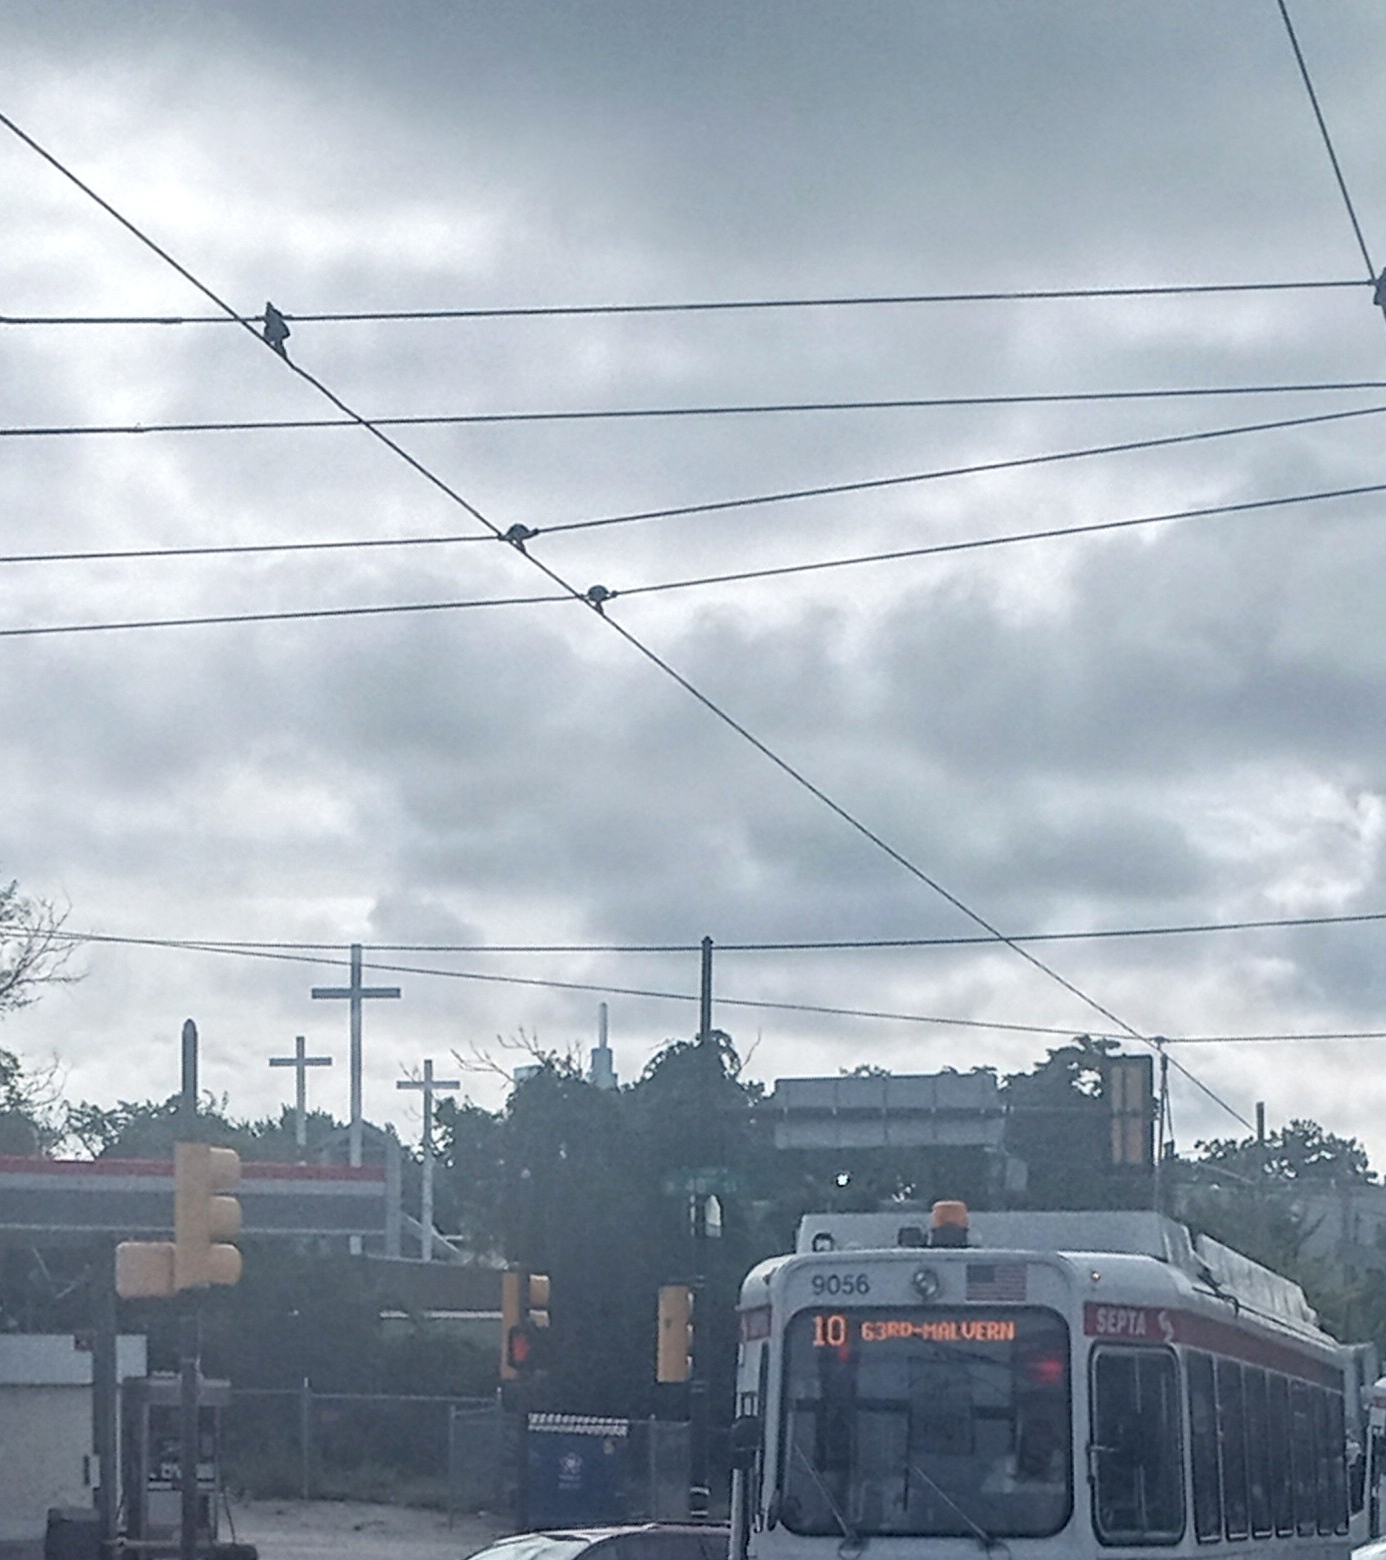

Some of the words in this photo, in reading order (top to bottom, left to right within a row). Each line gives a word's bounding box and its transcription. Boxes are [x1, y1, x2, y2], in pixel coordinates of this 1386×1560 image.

[812, 1273, 871, 1296] 9056
[813, 1314, 847, 1347] 10
[1095, 1306, 1147, 1337] SEPTA
